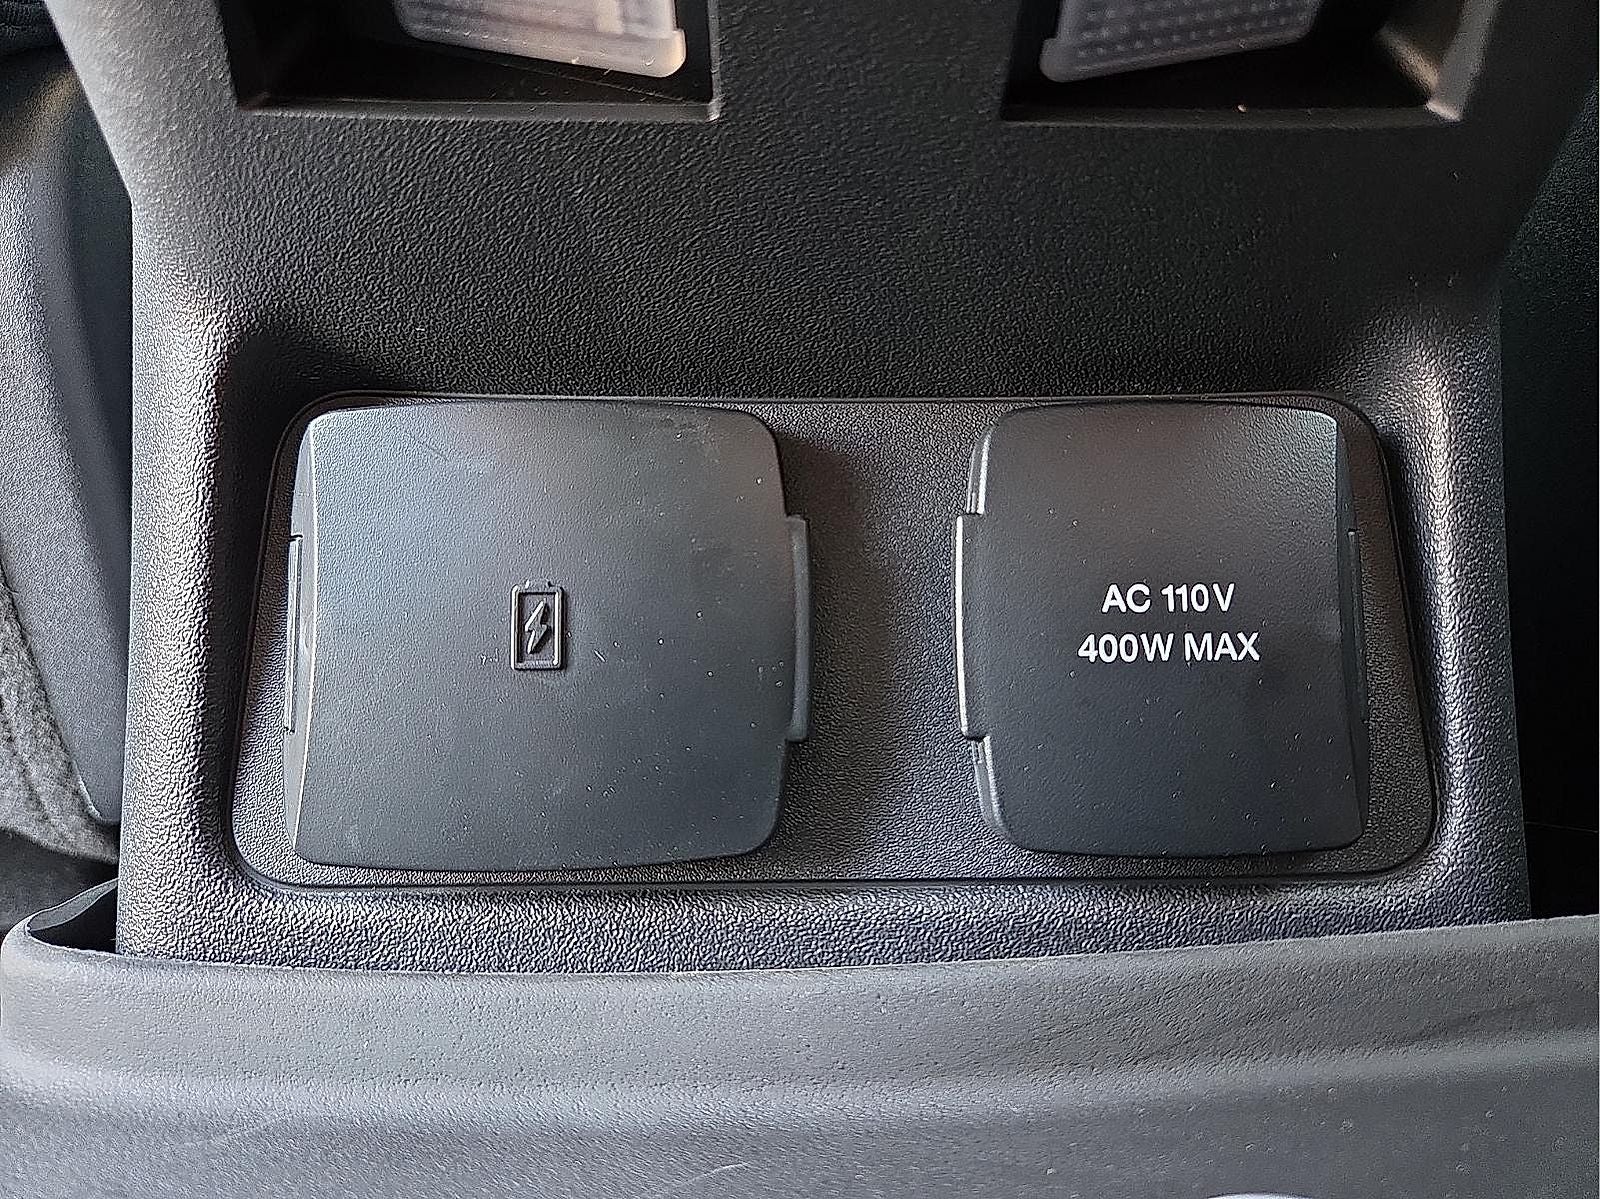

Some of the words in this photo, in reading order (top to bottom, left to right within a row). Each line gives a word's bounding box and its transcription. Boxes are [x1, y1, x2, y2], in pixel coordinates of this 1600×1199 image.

[1101, 583, 1151, 613] AC
[1161, 583, 1235, 612] 110V
[1077, 632, 1175, 663] 400W
[1184, 631, 1261, 662] MAX
